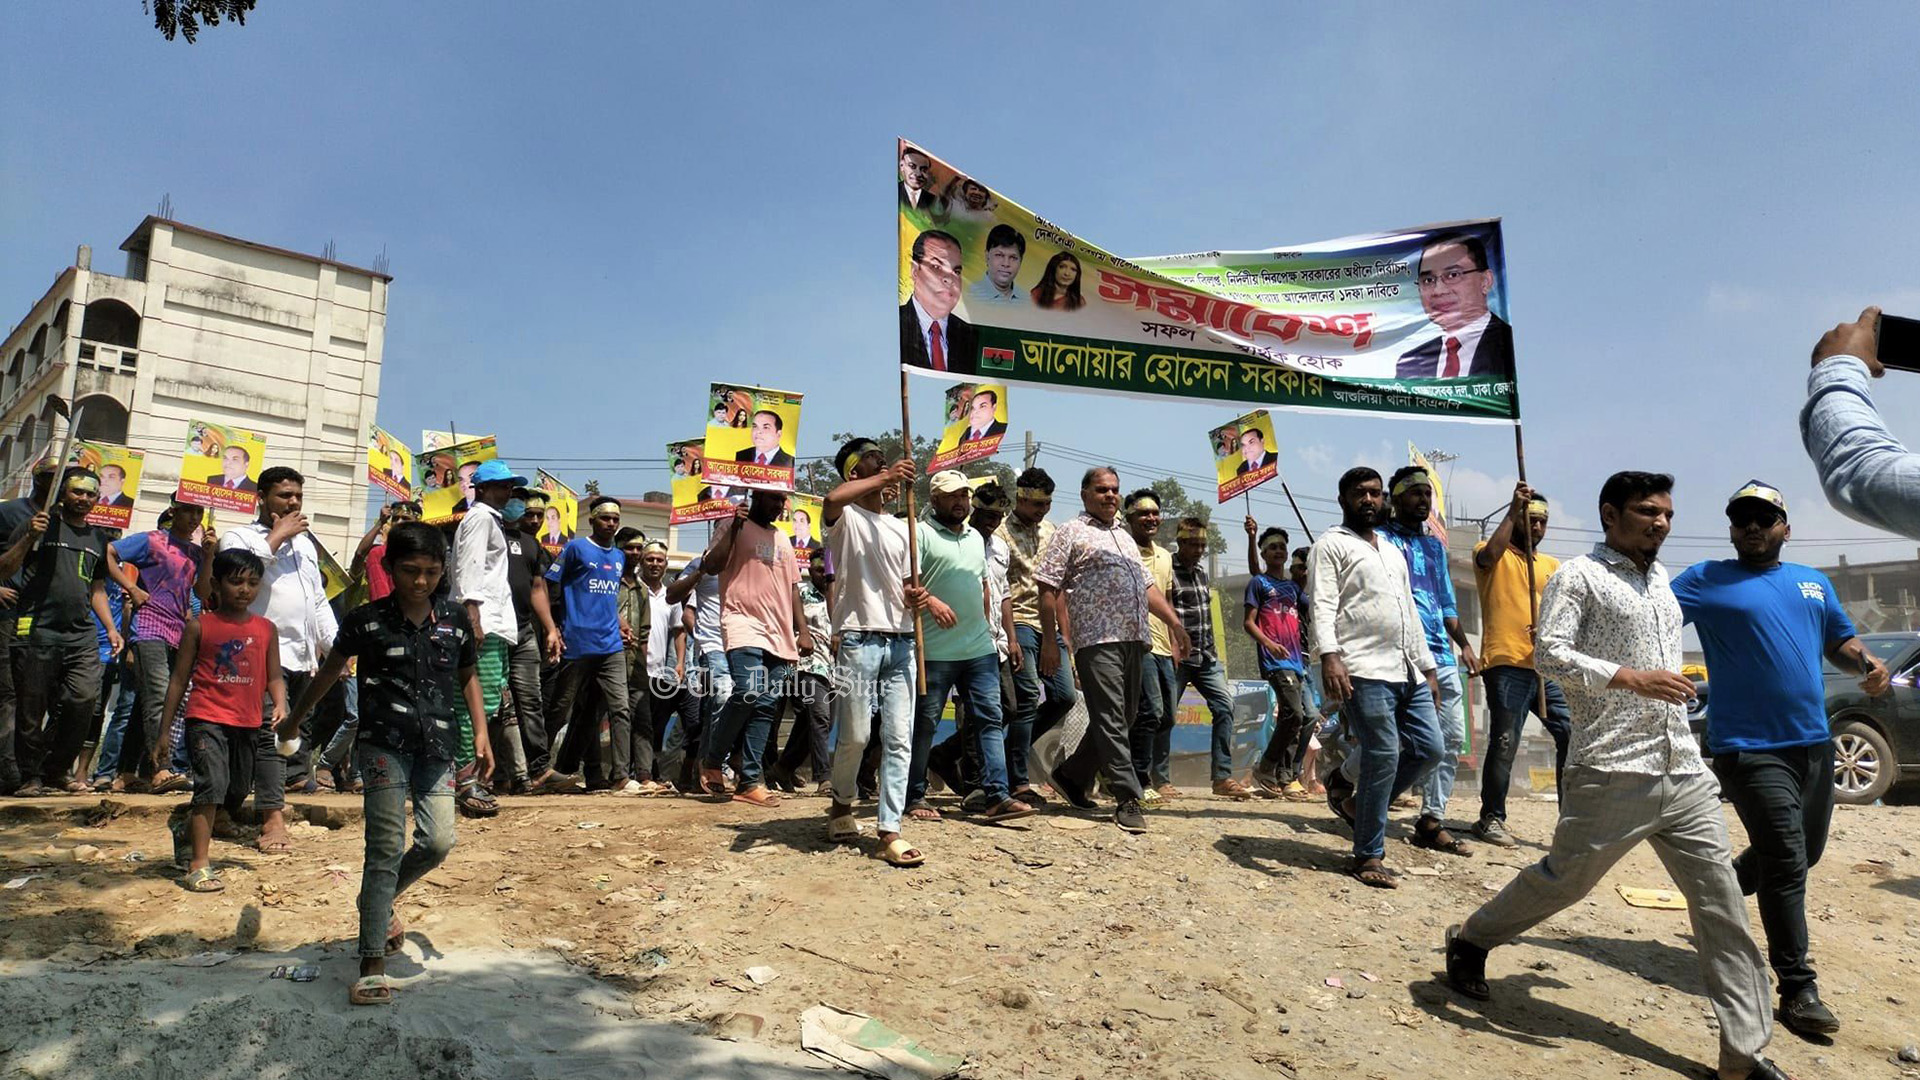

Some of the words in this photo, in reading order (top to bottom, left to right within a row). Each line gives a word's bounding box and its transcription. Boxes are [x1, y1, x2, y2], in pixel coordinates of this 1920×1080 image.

[1261, 268, 1298, 284] নিরপেক্ষ
[1300, 267, 1341, 283] সরকারের
[1343, 263, 1372, 279] অধীনে
[1375, 259, 1412, 276] নির্বাচন,
[1282, 291, 1335, 304] আন্দোলনের
[1339, 287, 1364, 302] ১দফা
[1366, 283, 1400, 300] দাবিতে
[1097, 269, 1376, 351] সমাবেশ
[1141, 320, 1196, 342] সফল
[1297, 354, 1344, 371] হোক
[1020, 338, 1138, 382] আনোয়ার
[1145, 352, 1236, 391] হোসেন
[1239, 361, 1324, 398] সরকার
[1332, 389, 1383, 406] আশুলিয়া
[1386, 393, 1412, 408] থানা
[1472, 382, 1491, 396] ঢাকা
[707, 460, 739, 475] আনোয়ার
[741, 464, 766, 478] হোসেন
[767, 467, 791, 481] সরকার
[217, 674, 255, 686] Zachary
